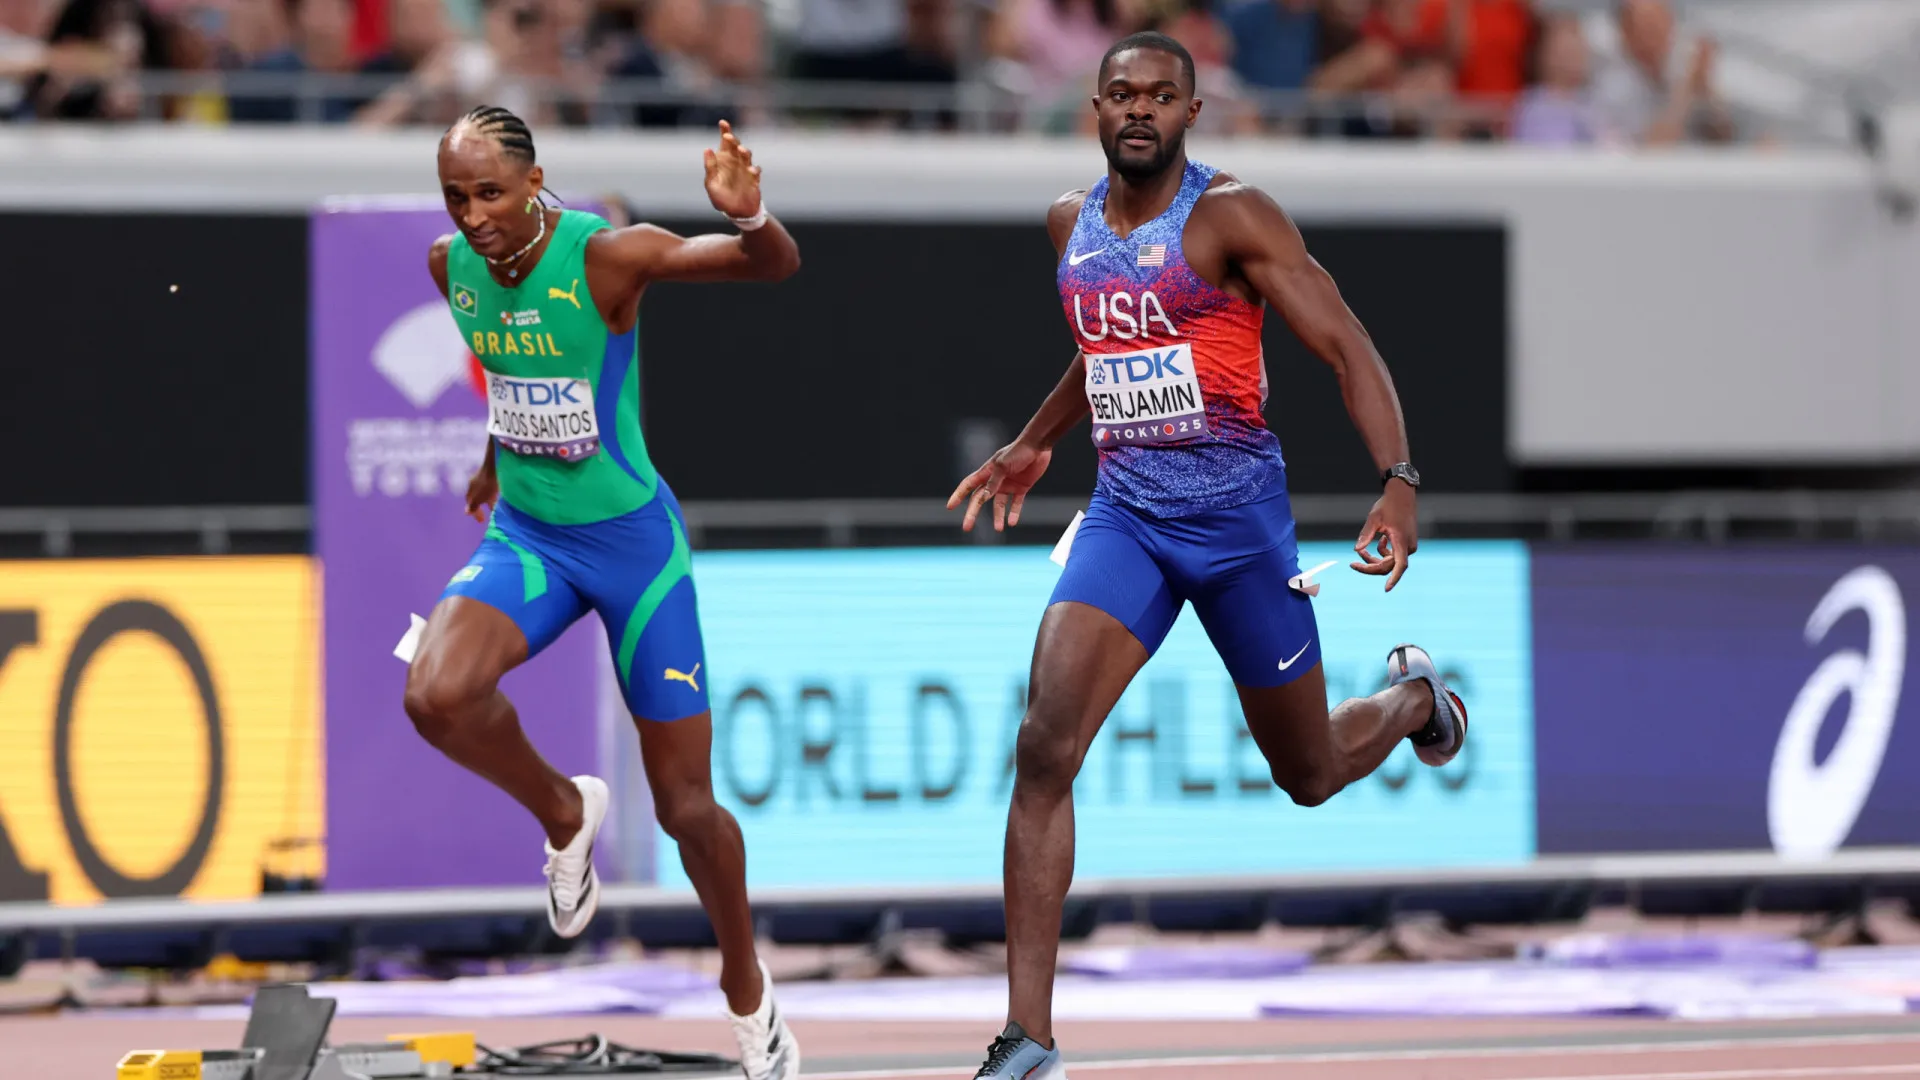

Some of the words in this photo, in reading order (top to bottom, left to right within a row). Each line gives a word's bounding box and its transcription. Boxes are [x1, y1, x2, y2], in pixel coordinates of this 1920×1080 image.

[1074, 291, 1178, 341] USA
[473, 331, 562, 356] BRASIL
[1103, 350, 1184, 384] TDK
[505, 381, 580, 405] TDK
[1091, 383, 1196, 420] BENJAMIN
[530, 410, 592, 438] SANTOS
[722, 684, 968, 806] ORLD
